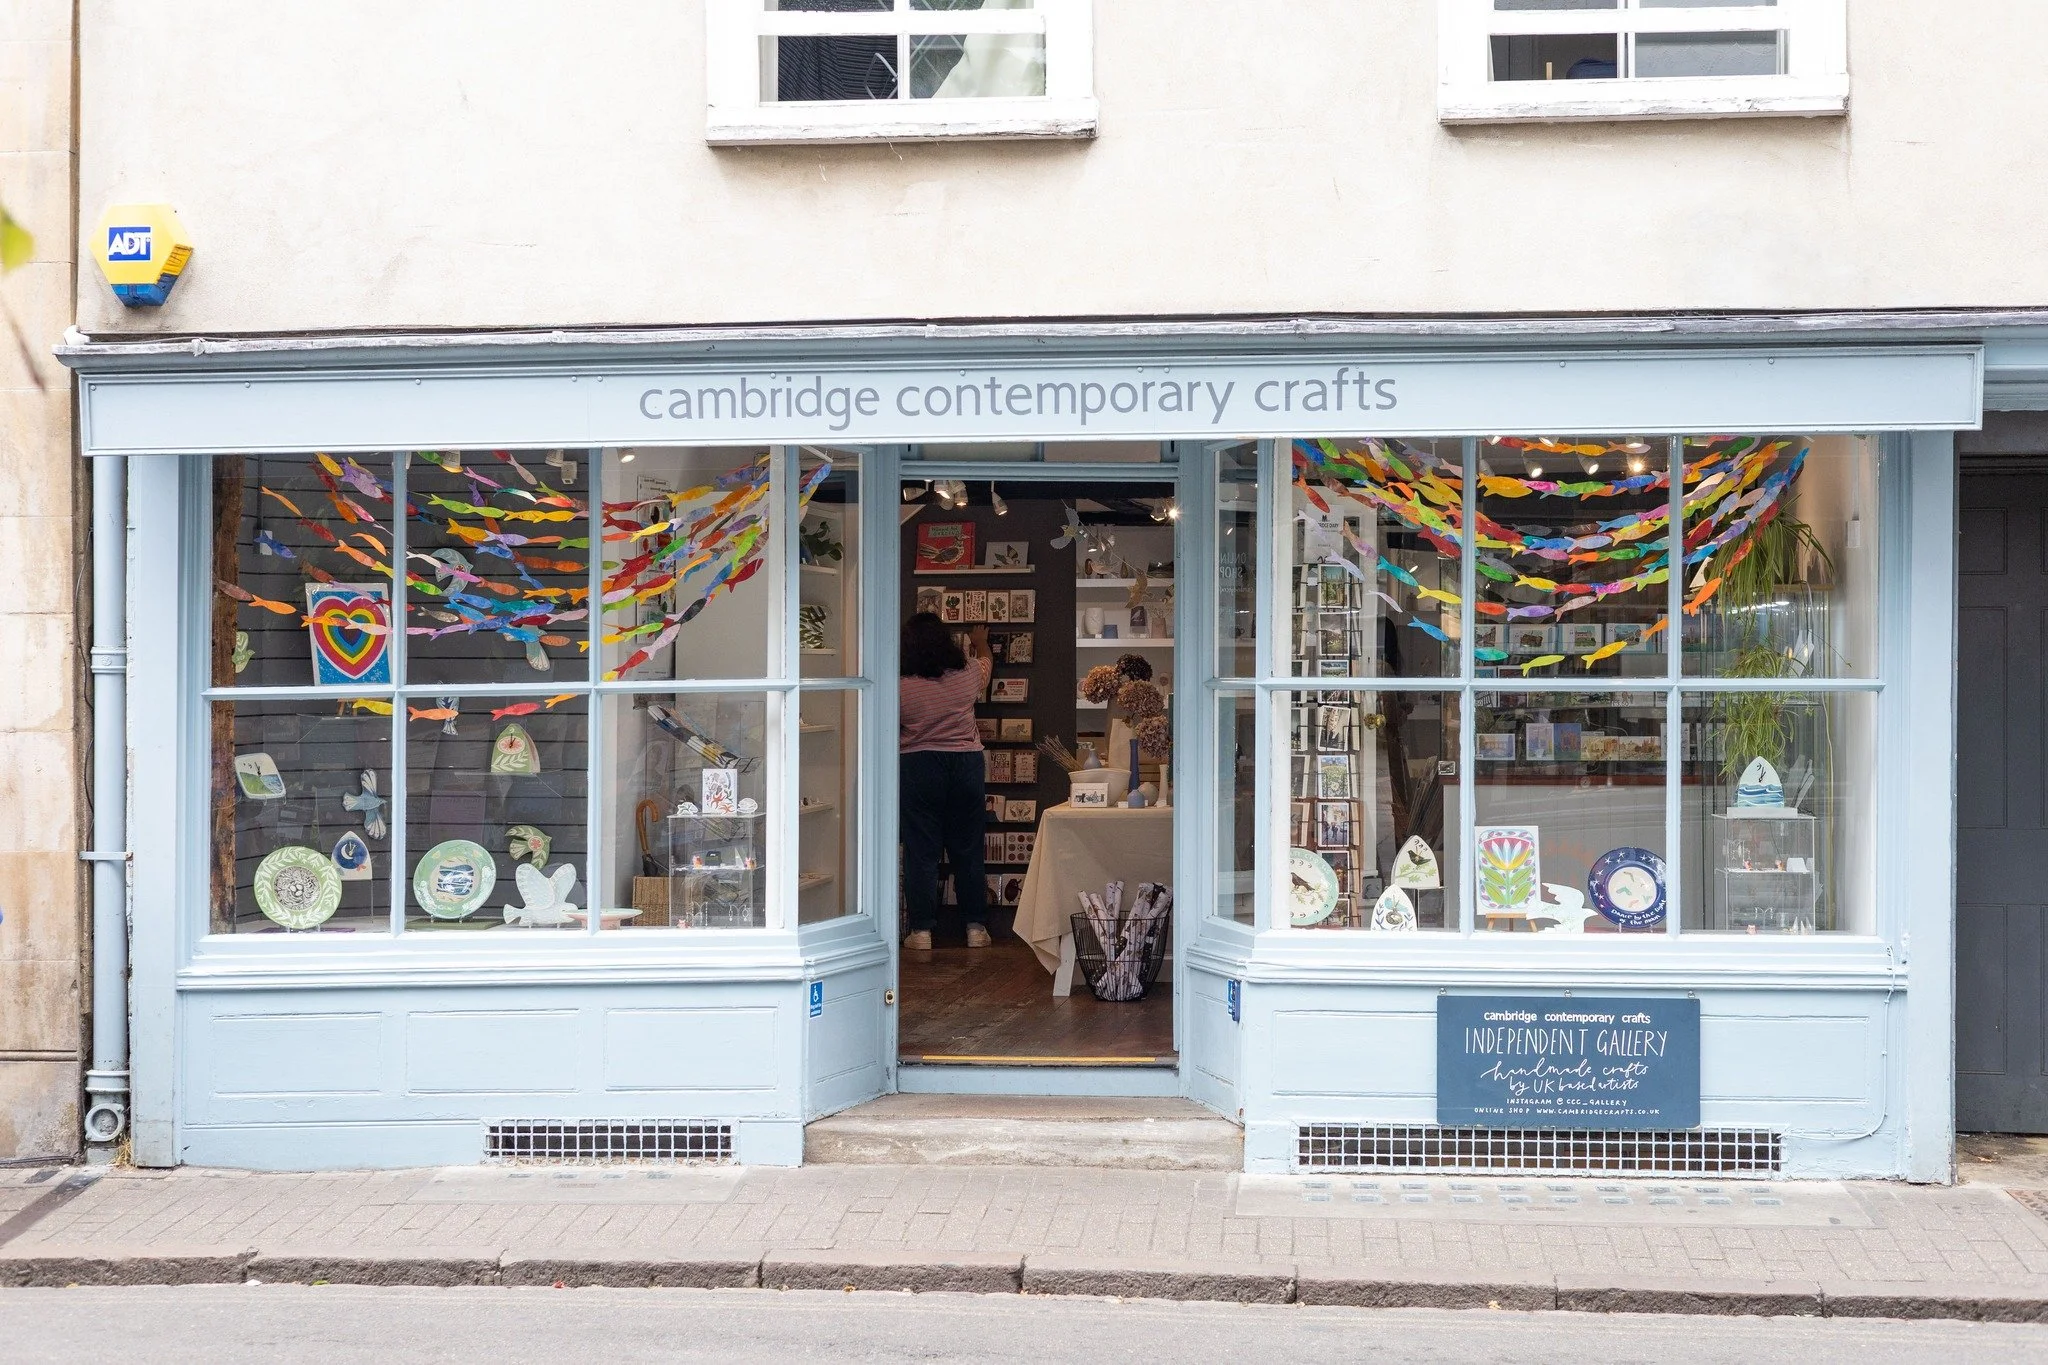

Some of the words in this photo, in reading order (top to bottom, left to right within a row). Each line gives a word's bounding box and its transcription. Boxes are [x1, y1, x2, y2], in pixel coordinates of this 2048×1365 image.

[108, 231, 151, 256] ADT
[639, 376, 881, 431] cambridge
[896, 376, 1235, 427] contemporary
[1254, 366, 1398, 412] crafts
[1483, 1010, 1538, 1024] cambridge
[1544, 1011, 1615, 1025] contemporary
[1621, 1012, 1651, 1024] crafts
[1465, 1027, 1588, 1055] INDEPENDENT
[1596, 1029, 1667, 1057] GALLERY
[1480, 1057, 1592, 1081] handmade
[1602, 1061, 1650, 1079] crafts
[1509, 1075, 1531, 1097] by
[1533, 1078, 1556, 1094] UK
[1558, 1076, 1597, 1093] based
[1597, 1078, 1640, 1092] artists
